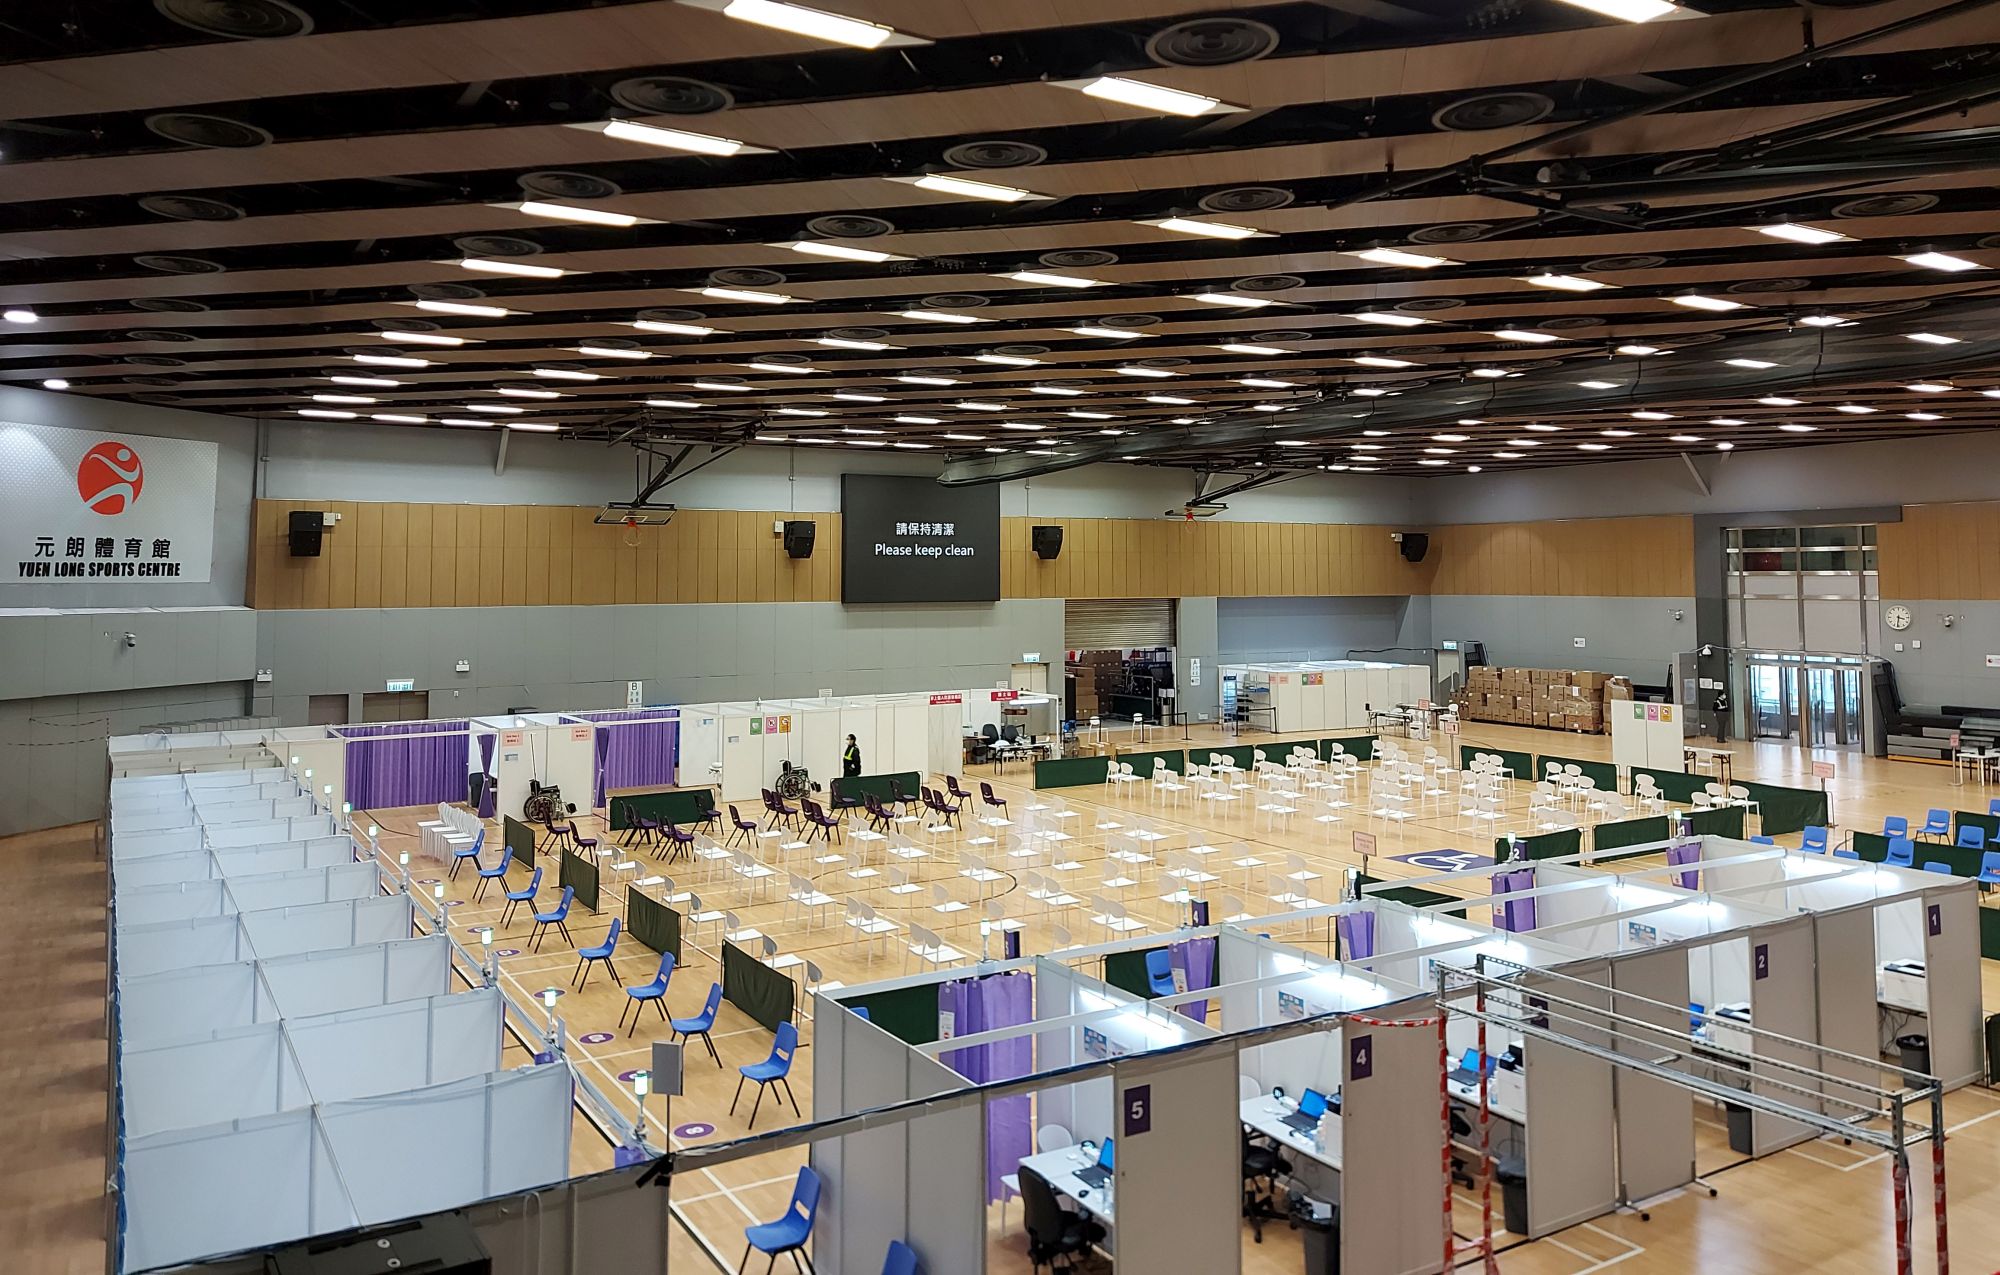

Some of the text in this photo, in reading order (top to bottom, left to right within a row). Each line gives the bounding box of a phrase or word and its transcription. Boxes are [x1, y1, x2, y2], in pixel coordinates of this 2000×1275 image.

[895, 522, 955, 536] 請保持清潔
[34, 536, 171, 559] 元朗體育館
[875, 543, 974, 559] Please keep clean
[18, 561, 181, 577] YUEN LONG SPORTS CENTRE
[631, 682, 638, 691] B
[1513, 848, 1520, 860] 2
[1193, 910, 1199, 924] 4
[1932, 913, 1937, 926] 1
[1758, 954, 1765, 969] 2
[1356, 1048, 1367, 1065] 4
[1131, 1100, 1144, 1120] 5
